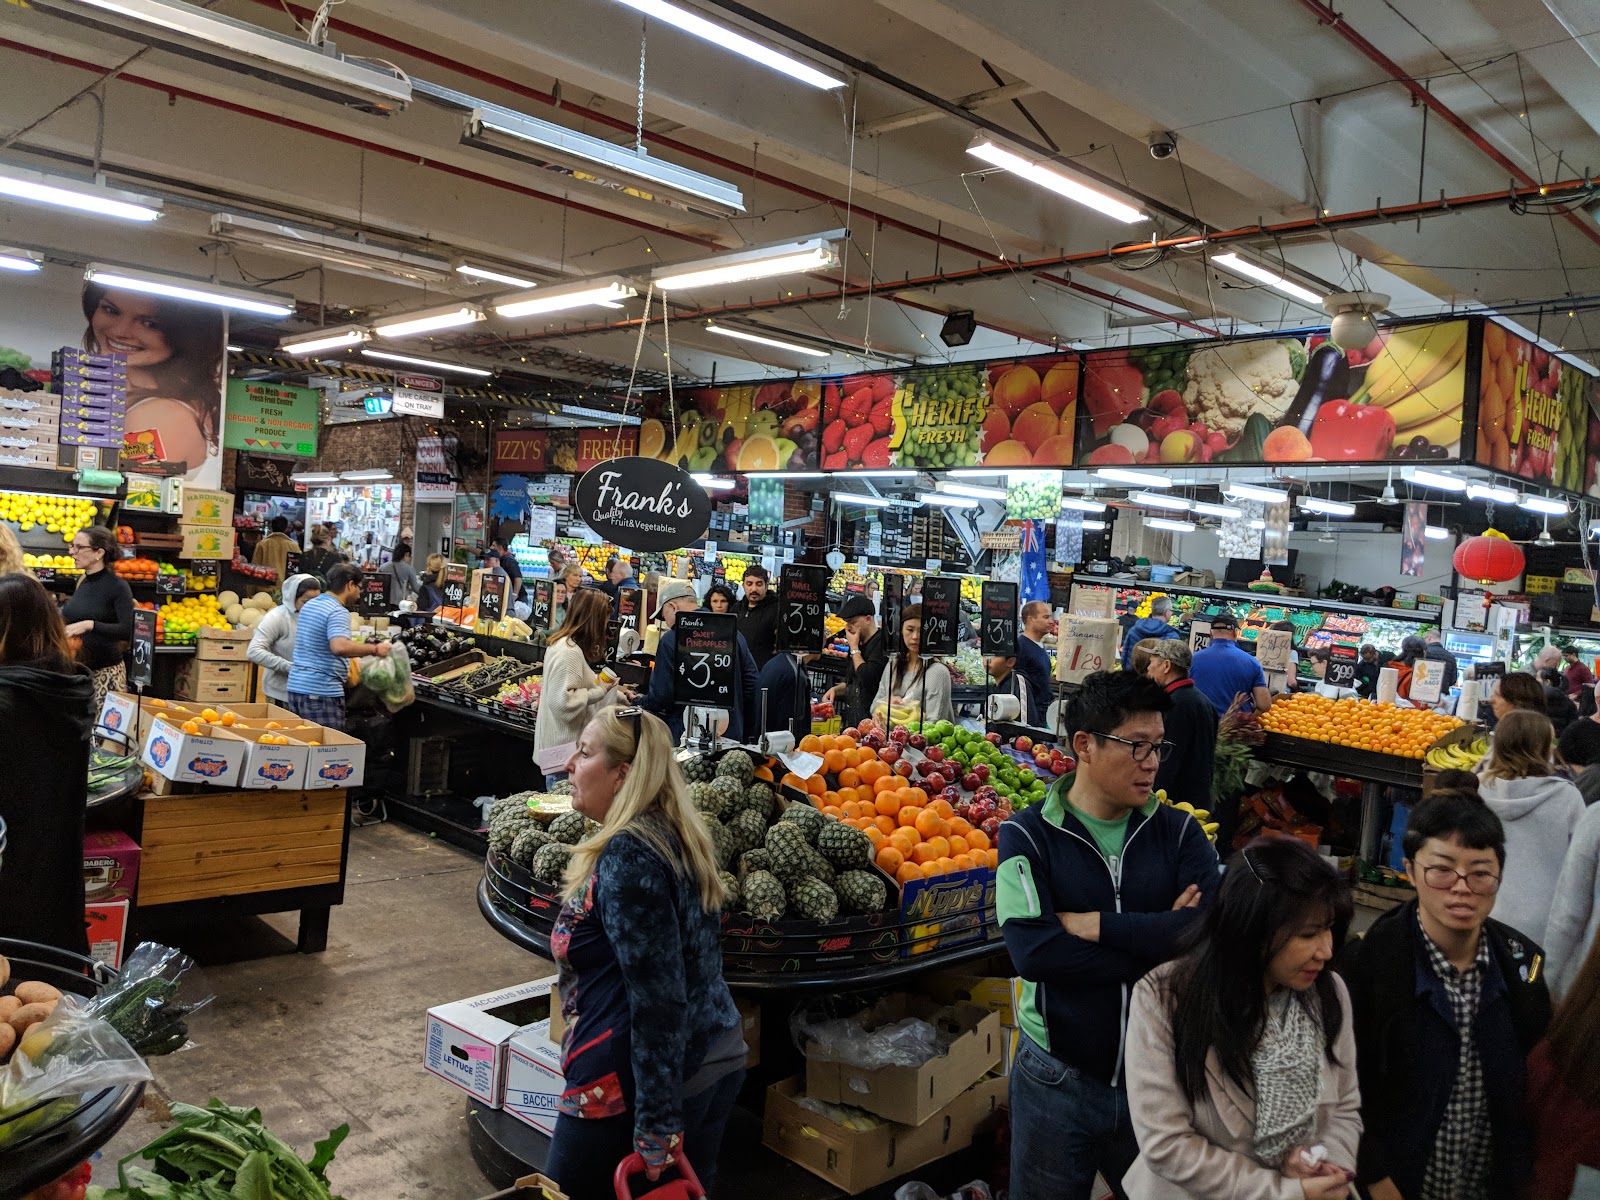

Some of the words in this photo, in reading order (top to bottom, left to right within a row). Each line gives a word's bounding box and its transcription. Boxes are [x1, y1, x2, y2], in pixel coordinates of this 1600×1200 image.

[404, 378, 435, 388] DANGER
[245, 385, 265, 394] South
[265, 387, 297, 399] Melbourne
[414, 394, 439, 403] CABLES
[249, 394, 263, 402] Fresh
[276, 397, 293, 406] Centre
[261, 408, 283, 416] FRESH
[416, 403, 432, 411] TRAY
[227, 413, 258, 424] ORGANIC
[267, 419, 282, 427] NON
[284, 420, 313, 430] ORGANIC
[254, 427, 287, 437] PRODUCE
[917, 429, 967, 444] FRESH
[1527, 428, 1551, 452] FRESH
[497, 440, 541, 460] IZZY'S
[582, 439, 635, 460] FRESH
[187, 494, 230, 505] HARDINGS
[597, 470, 692, 518] Frank's
[593, 505, 623, 522] Quality
[188, 528, 230, 538] HARDINGS
[791, 581, 812, 591] NAVEL
[786, 590, 818, 600] ORANGES
[692, 630, 715, 638] SWEET
[685, 637, 728, 649] PINEAPPLES
[84, 859, 115, 867] DABERG
[907, 879, 984, 917] Nippy's
[516, 983, 551, 997] MARSH
[536, 1046, 561, 1060] FRES
[443, 1054, 473, 1075] LETTUCE
[523, 1094, 560, 1109] BACCHU
